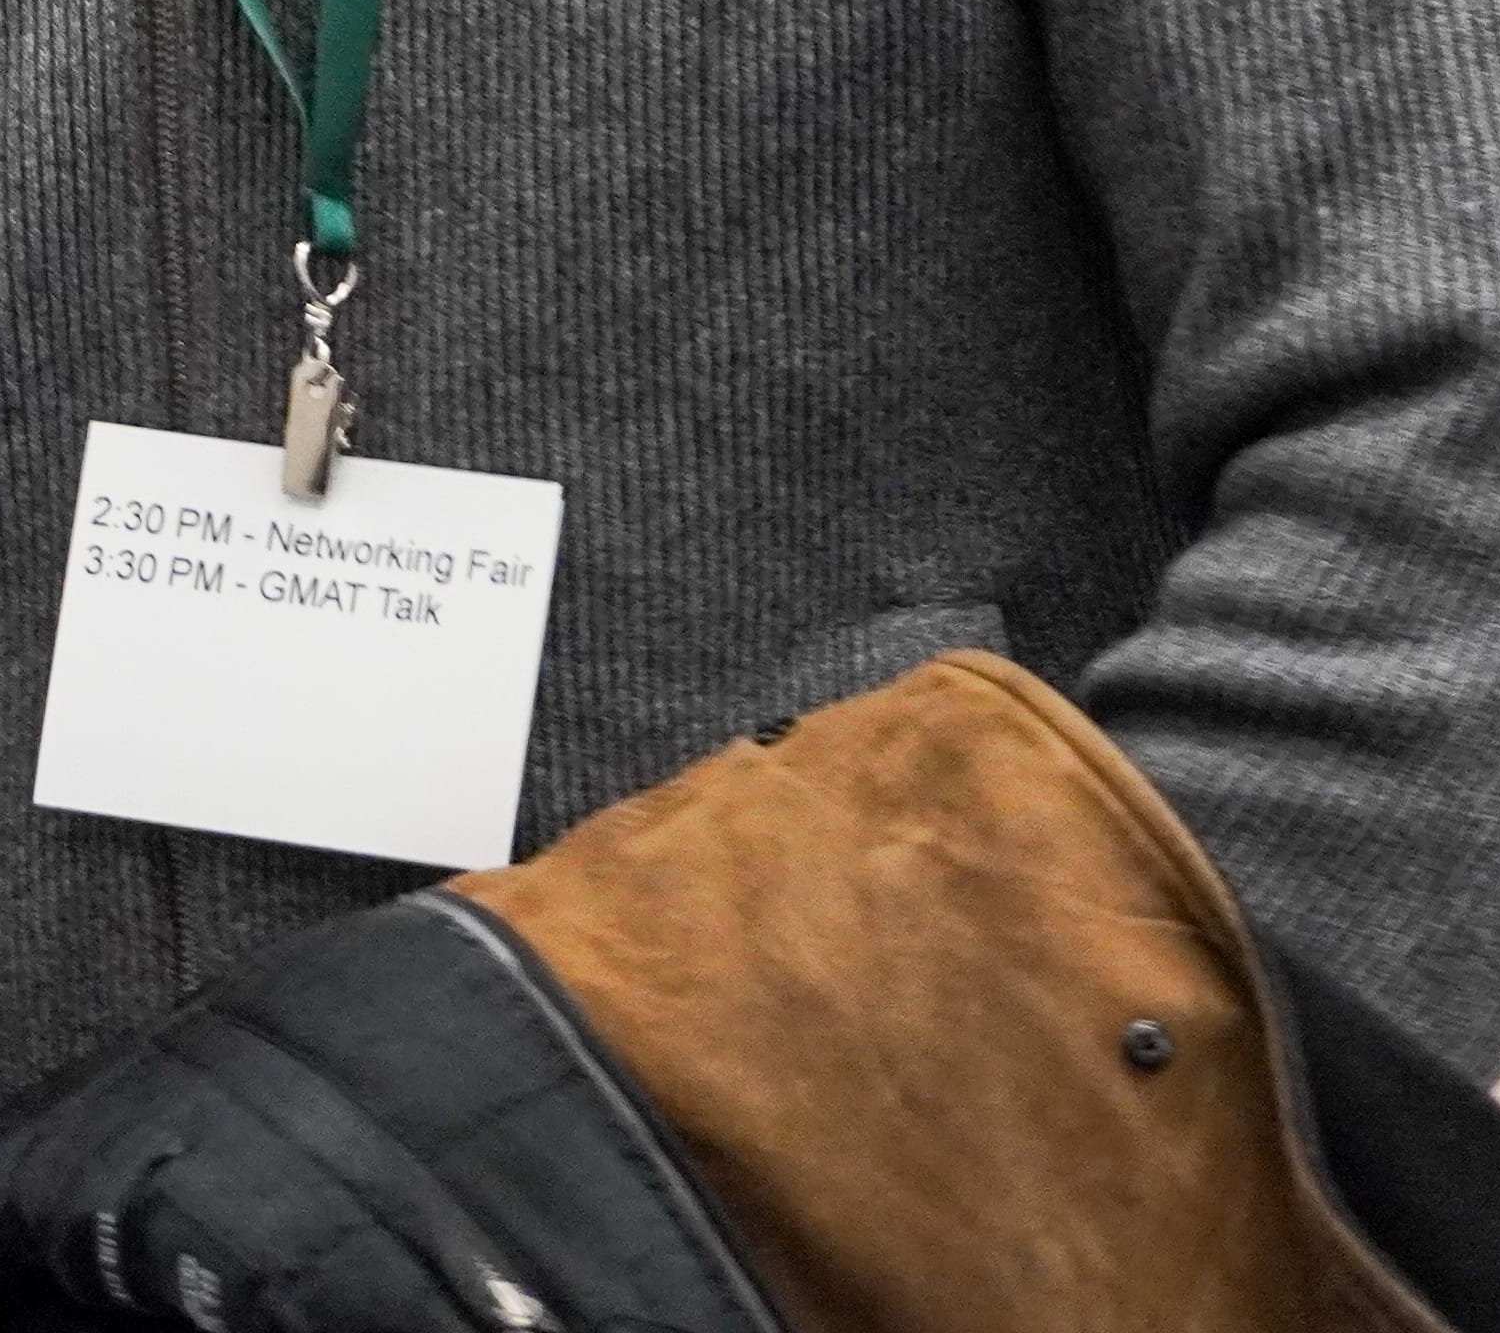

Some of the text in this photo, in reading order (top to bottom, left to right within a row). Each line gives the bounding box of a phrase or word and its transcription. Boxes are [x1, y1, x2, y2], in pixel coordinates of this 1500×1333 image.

[84, 544, 157, 584] 3:30
[168, 556, 225, 594] PM
[259, 570, 368, 614] GMAT
[378, 585, 442, 626] Talk
[91, 495, 165, 535] 2:30
[176, 507, 233, 546] PM
[265, 520, 455, 584] Networking
[467, 547, 534, 589] Fair
